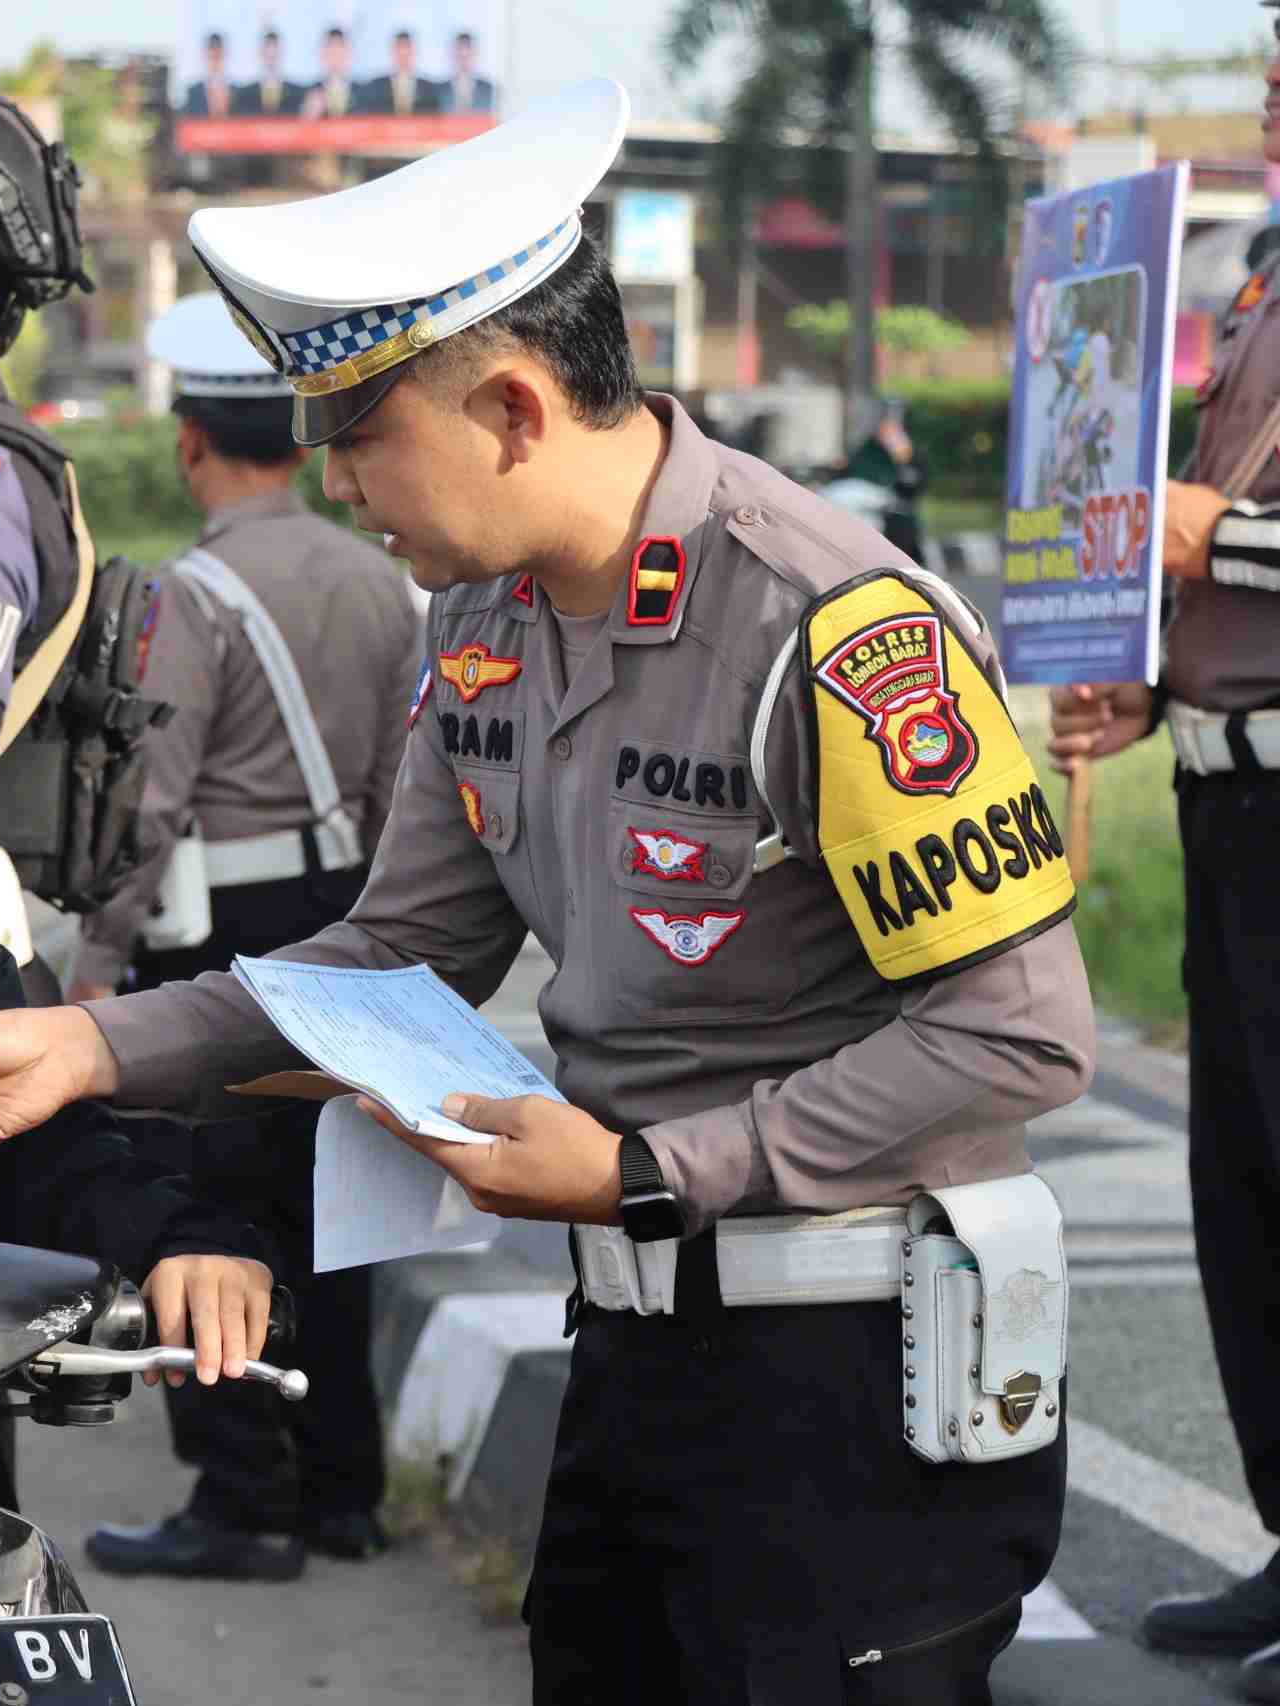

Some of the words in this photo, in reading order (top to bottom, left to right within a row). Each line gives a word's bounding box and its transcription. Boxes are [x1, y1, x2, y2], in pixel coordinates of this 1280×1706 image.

[1082, 488, 1148, 577] STOP
[841, 626, 925, 675] POLRES
[847, 652, 891, 688] LOMBOK
[889, 642, 928, 663] BARAT
[616, 747, 746, 810] POLRI
[853, 783, 1064, 936] KAPOSKO
[14, 1628, 94, 1682] BV
